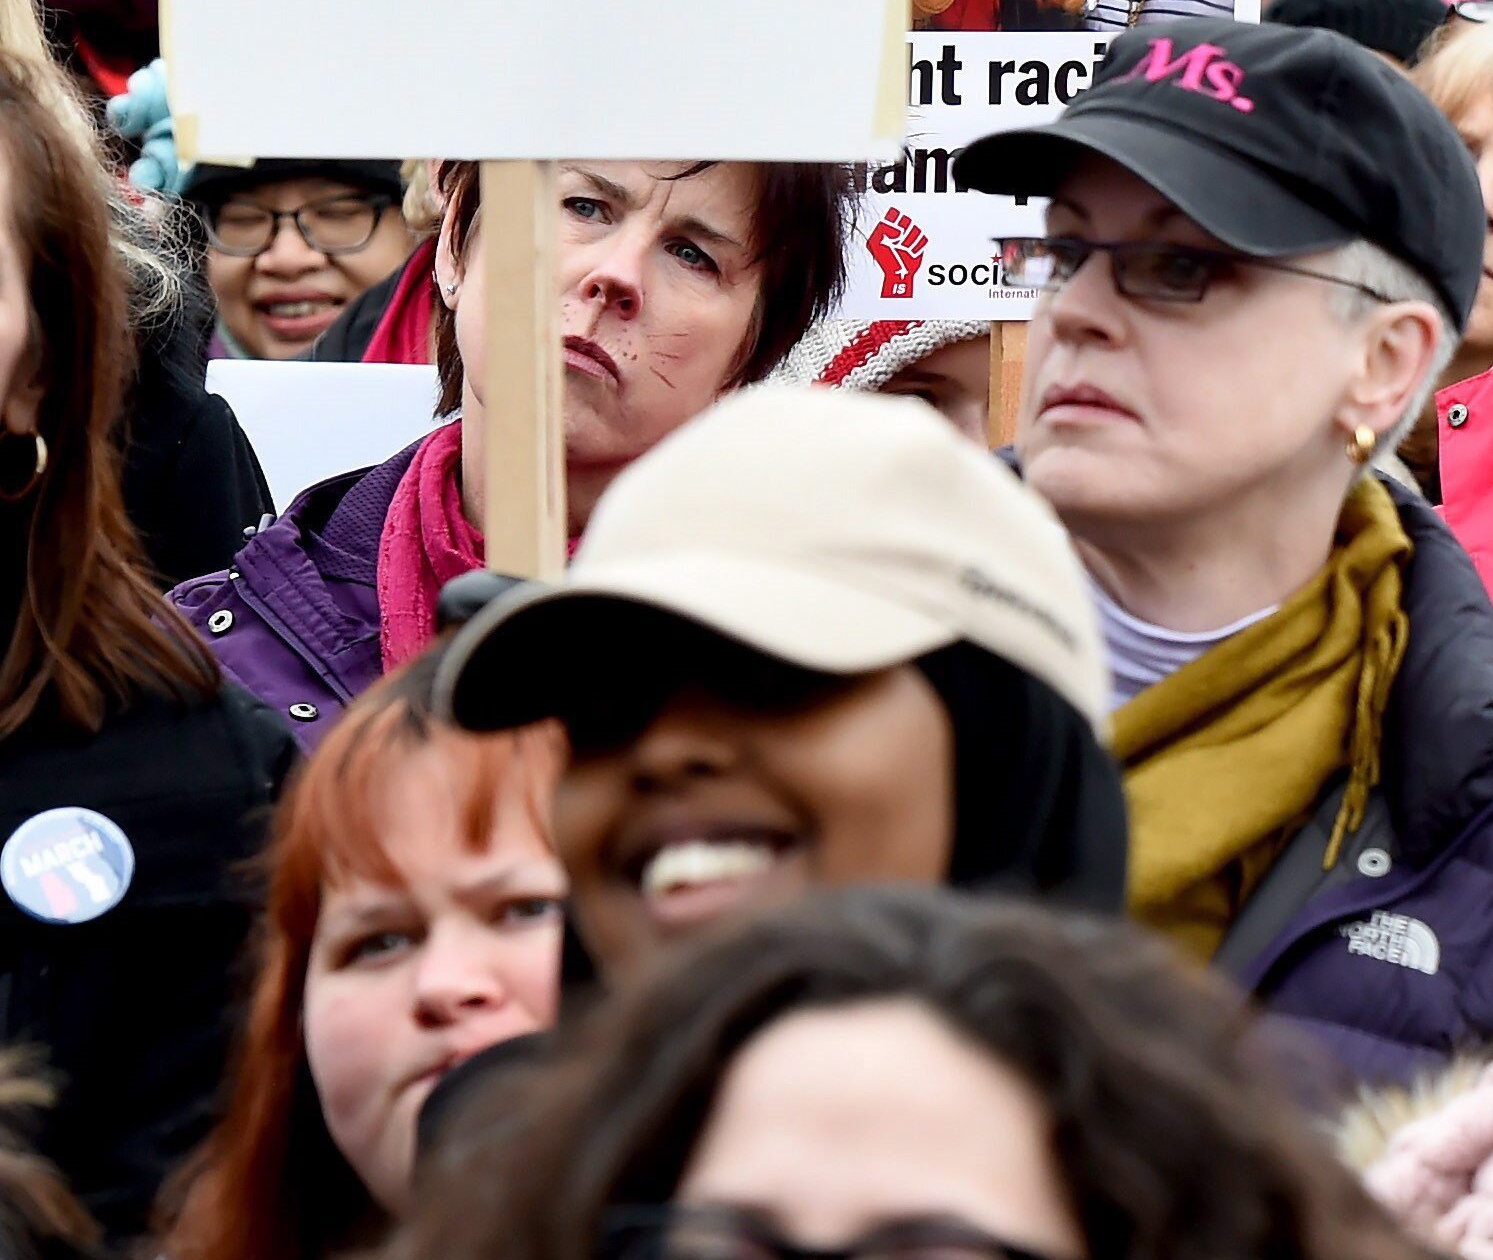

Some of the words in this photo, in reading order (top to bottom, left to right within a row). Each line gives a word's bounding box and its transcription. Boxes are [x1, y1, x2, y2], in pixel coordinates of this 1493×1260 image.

[1128, 37, 1255, 113] Ms.
[20, 830, 105, 878] MARCH
[1371, 910, 1409, 934] THE
